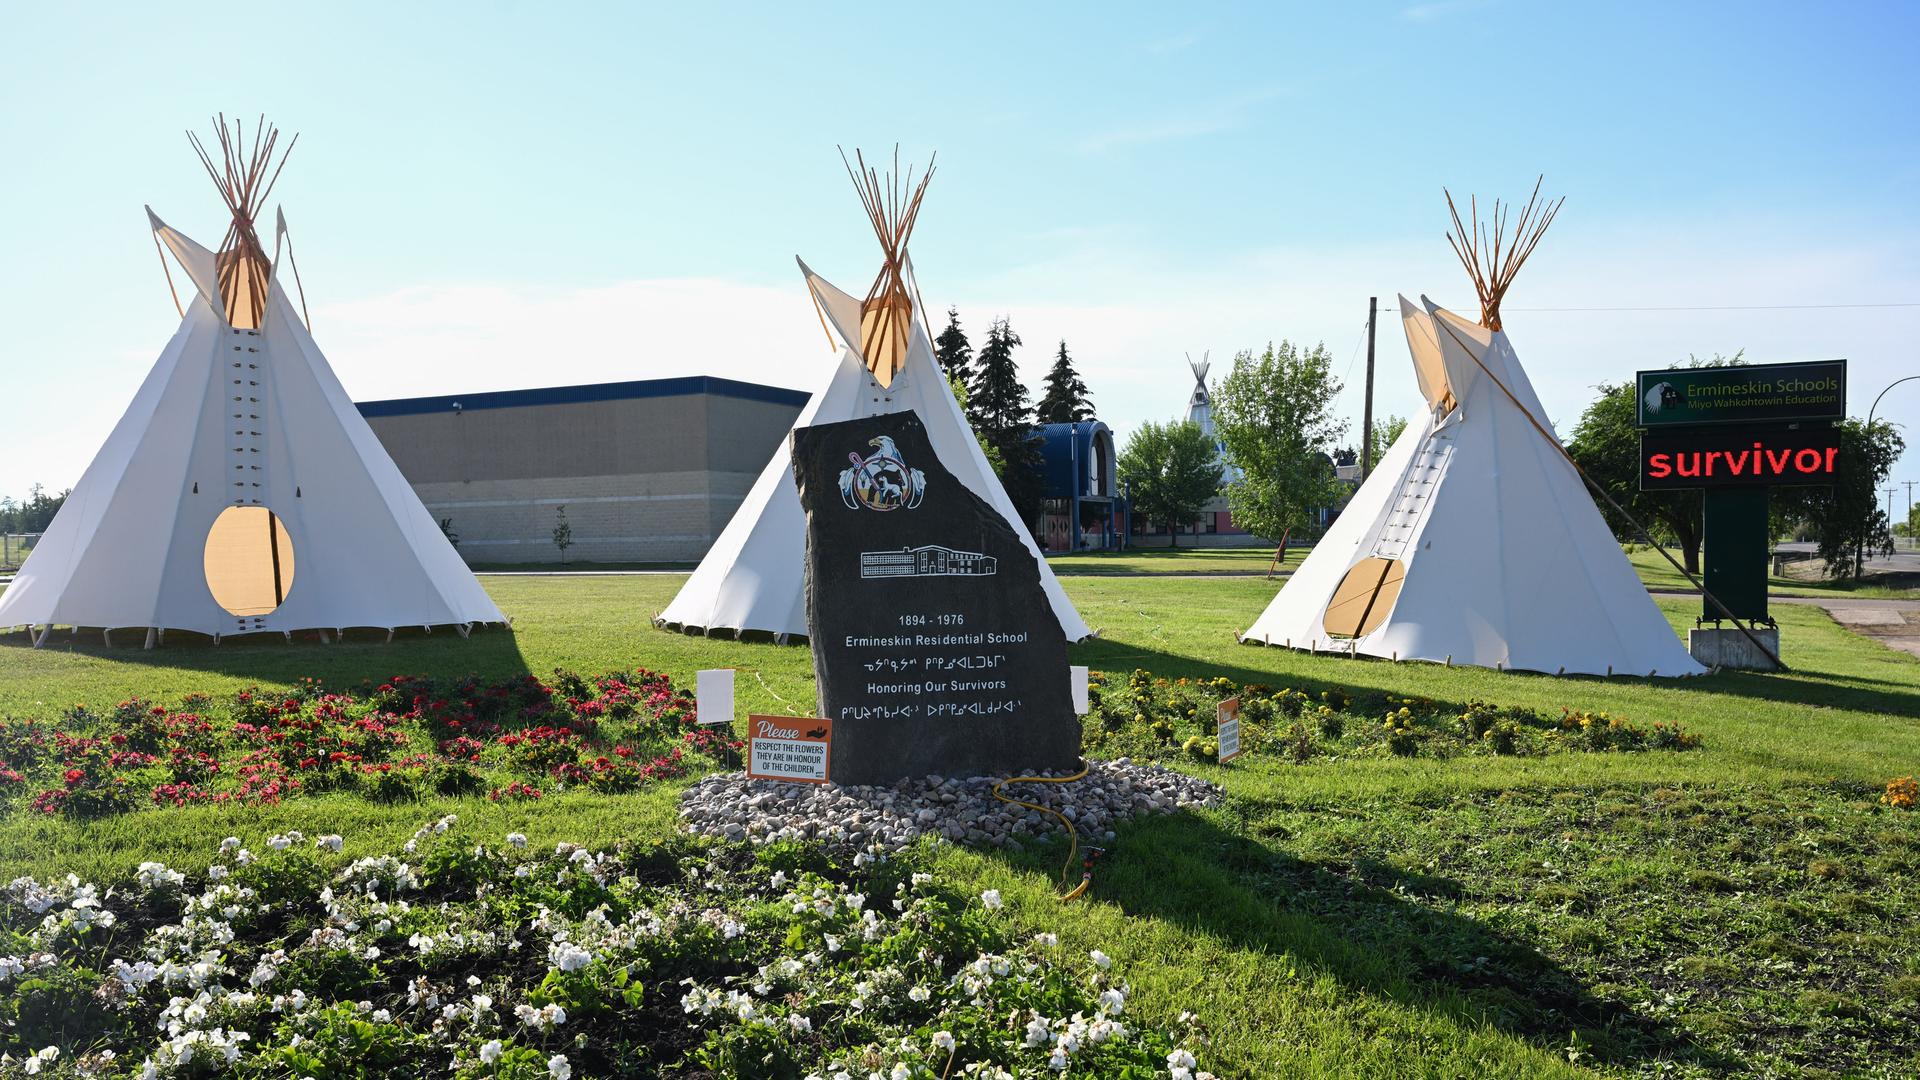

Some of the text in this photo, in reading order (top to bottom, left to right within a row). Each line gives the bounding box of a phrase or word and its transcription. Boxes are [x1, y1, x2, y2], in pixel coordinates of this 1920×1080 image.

[1687, 377, 1838, 398] Ermineskin Schools
[1687, 393, 1837, 410] Miyo Wahkohtowin Education
[1648, 442, 1839, 479] survivor
[899, 615, 926, 626] 1894
[937, 614, 964, 626] 1976
[845, 631, 1028, 648] Ermineskin Residential School
[867, 678, 1006, 695] Honoring Our Survivors
[757, 721, 800, 739] Please
[754, 742, 824, 754] RESPECT THE FLOWERS
[757, 751, 821, 764] THEY ARE IN HONOUR
[762, 762, 814, 773] OF THE CHILDREN
